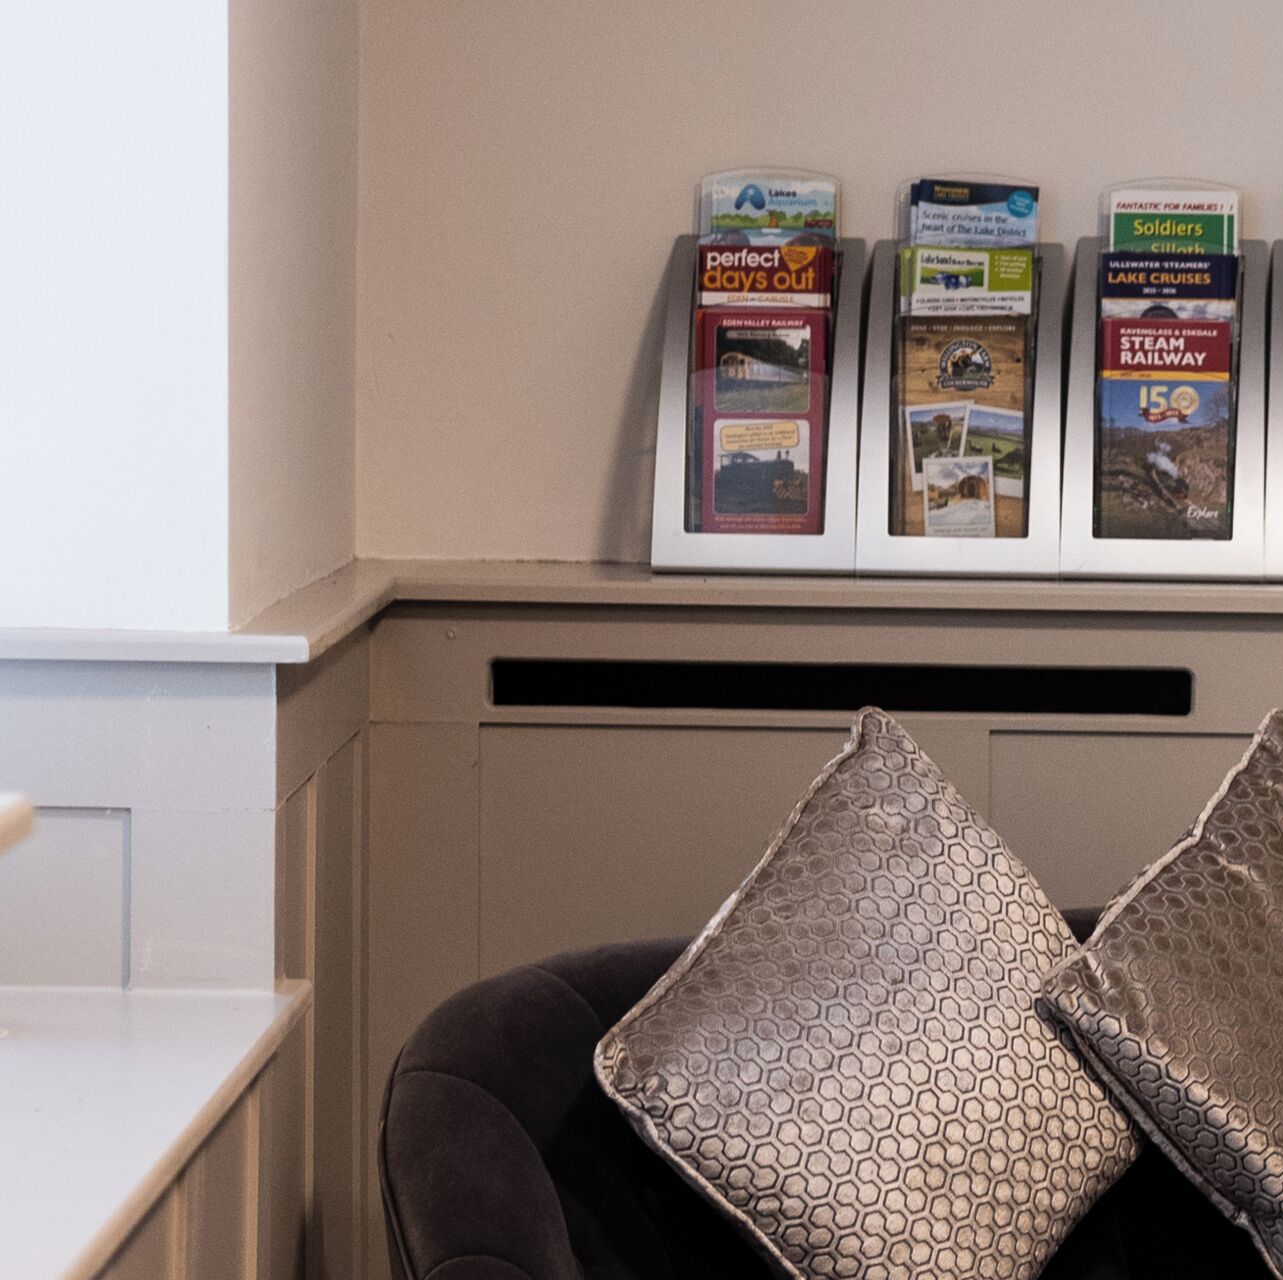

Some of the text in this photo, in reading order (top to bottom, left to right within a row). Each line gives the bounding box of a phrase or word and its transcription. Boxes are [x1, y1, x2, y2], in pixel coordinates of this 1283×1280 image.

[768, 189, 797, 198] Lakes
[1116, 202, 1160, 210] FANTASTIC
[1163, 202, 1180, 211] FOR
[1182, 203, 1218, 211] FAMILIES
[922, 210, 949, 220] Scenic
[951, 212, 982, 222] cruises
[922, 223, 944, 233] heart
[1133, 218, 1203, 237] Soldiers
[706, 248, 780, 270] perfect
[1109, 261, 1160, 269] ULLSWATER
[703, 266, 815, 297] days out
[1107, 272, 1212, 285] LAKE CRUISES
[722, 319, 804, 327] EDEN VALLEY RAILWAY
[1120, 327, 1172, 336] RAVENGLASS
[1182, 329, 1218, 337] ESKDALE
[1120, 336, 1185, 351] STEAM
[1120, 351, 1207, 366] RAILWAY
